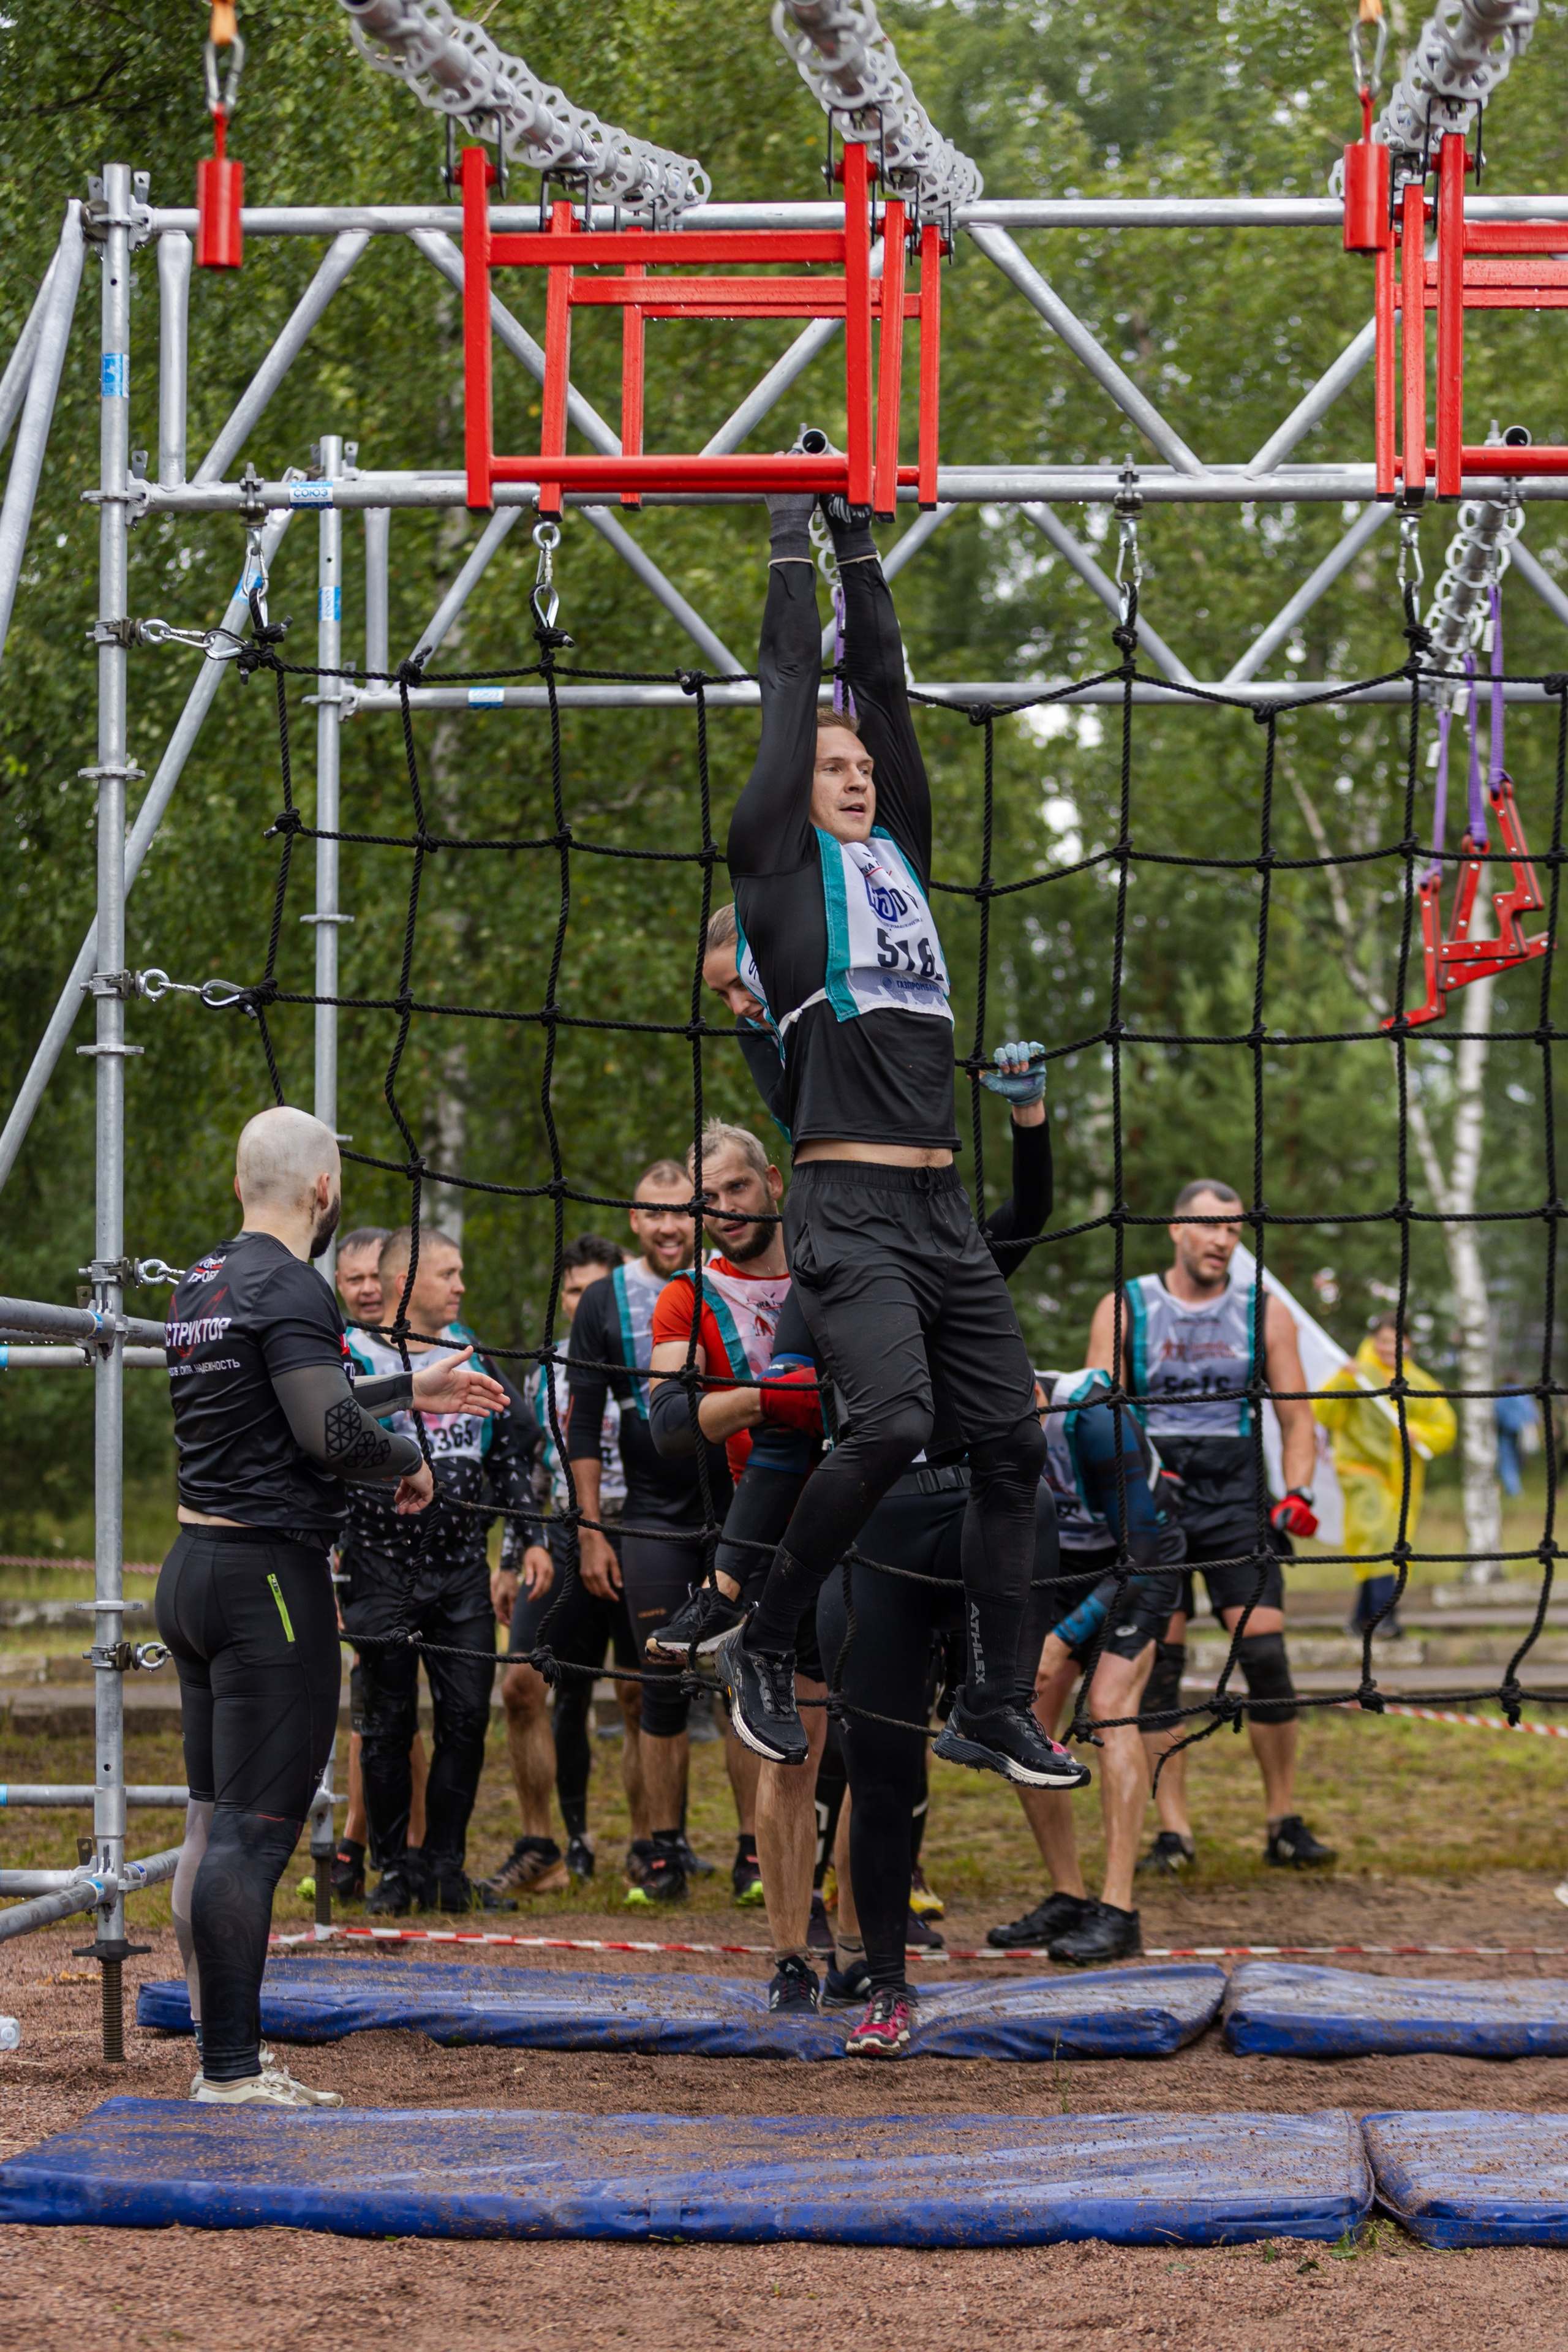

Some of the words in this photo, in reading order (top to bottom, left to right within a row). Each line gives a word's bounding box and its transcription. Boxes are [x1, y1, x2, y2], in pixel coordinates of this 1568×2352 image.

[293, 489, 328, 497] СОЮЗ
[896, 980, 942, 993] ГАЗПРОМБАНК
[164, 1317, 232, 1347] СТРУКТОР
[970, 1602, 985, 1684] ATHLEX
